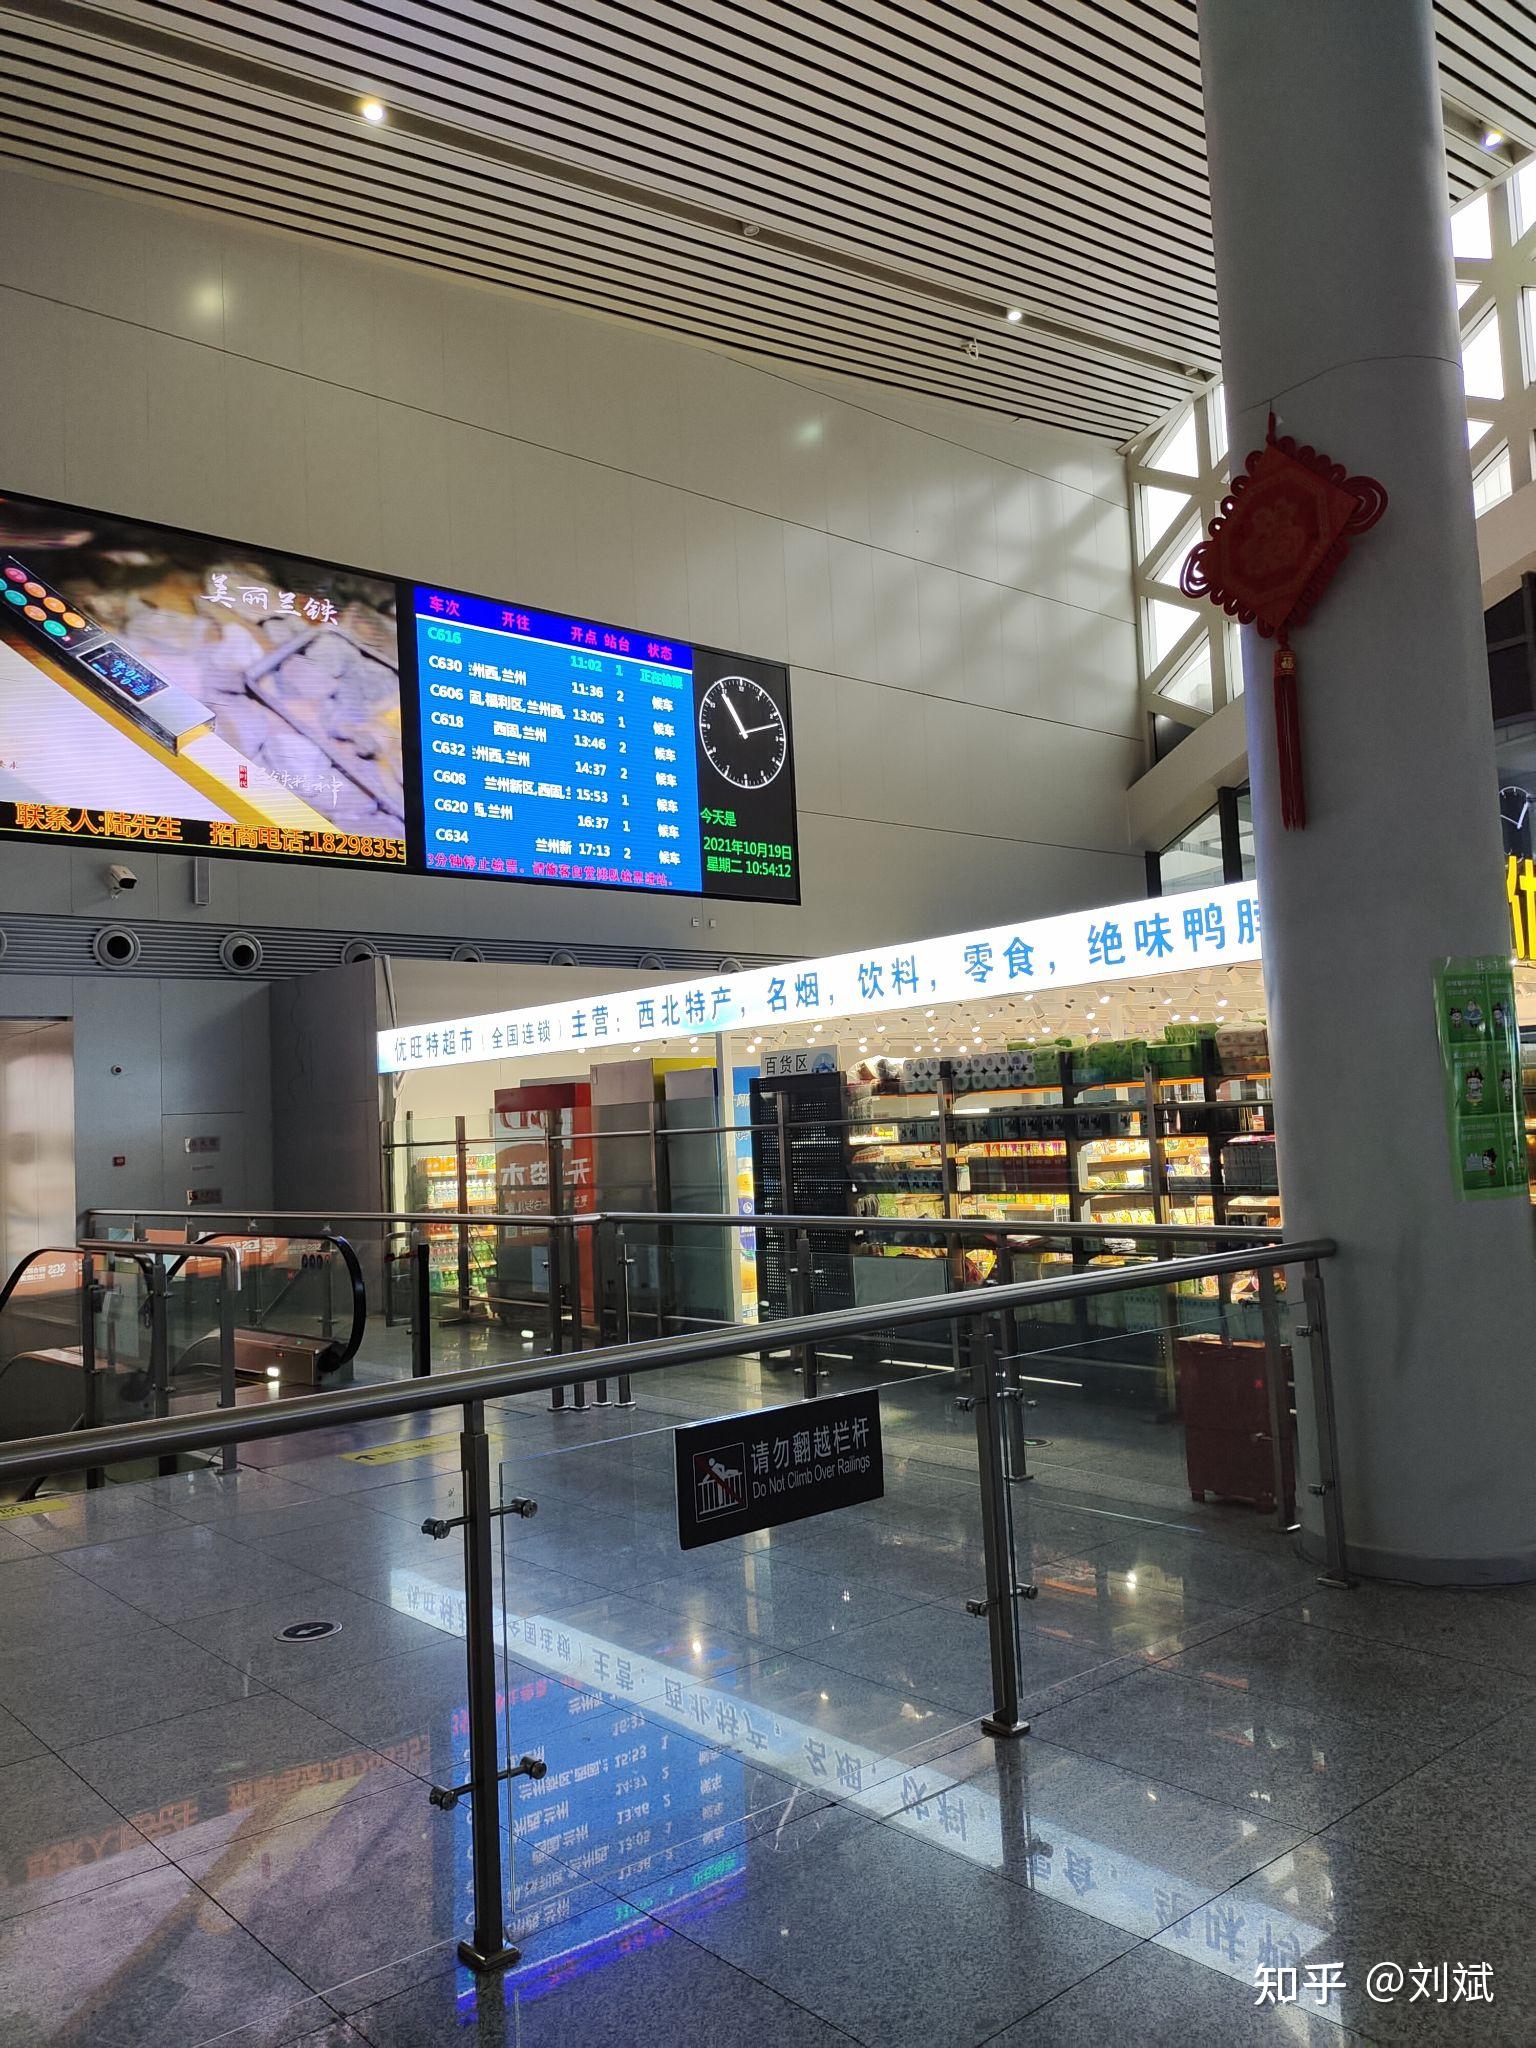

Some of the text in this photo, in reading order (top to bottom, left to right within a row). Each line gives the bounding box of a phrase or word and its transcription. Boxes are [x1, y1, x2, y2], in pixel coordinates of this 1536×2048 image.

[429, 596, 673, 661] 车次 开往 开点 站台 状态
[427, 626, 462, 644] C616
[570, 656, 602, 672] 11:02
[615, 664, 624, 677] 1
[428, 655, 463, 673] C630
[571, 681, 604, 698] 11:36
[616, 690, 625, 702] 2
[651, 695, 674, 712] 候车
[429, 683, 464, 701] C606
[572, 708, 605, 724] 13:05
[618, 716, 626, 728] 1
[652, 721, 676, 737] 候车
[431, 711, 464, 729] C618
[573, 734, 607, 750] 13:46
[619, 742, 627, 754] 2
[654, 746, 677, 762] 候车
[431, 740, 466, 756] C632
[575, 761, 607, 777] 14:37
[620, 767, 628, 780] 2
[655, 771, 678, 788] 候车
[433, 769, 467, 785] C608
[576, 788, 608, 803] 15:53
[621, 794, 630, 806] 1
[656, 797, 679, 813] 候车
[434, 798, 469, 814] C620
[577, 815, 609, 830] 16:37
[622, 820, 631, 832] 1
[657, 823, 680, 839] 候车
[700, 807, 738, 828] 今天是
[435, 828, 682, 866] C634 兰州新 17:13 2 候车
[703, 836, 792, 861] 2021年10月19日
[707, 856, 792, 878] 星期二 10:54:12
[764, 1053, 809, 1075] 百货区
[750, 1416, 870, 1476] 请勿翻越栏杆
[753, 1454, 871, 1499] Do Not Climb Over Railings
